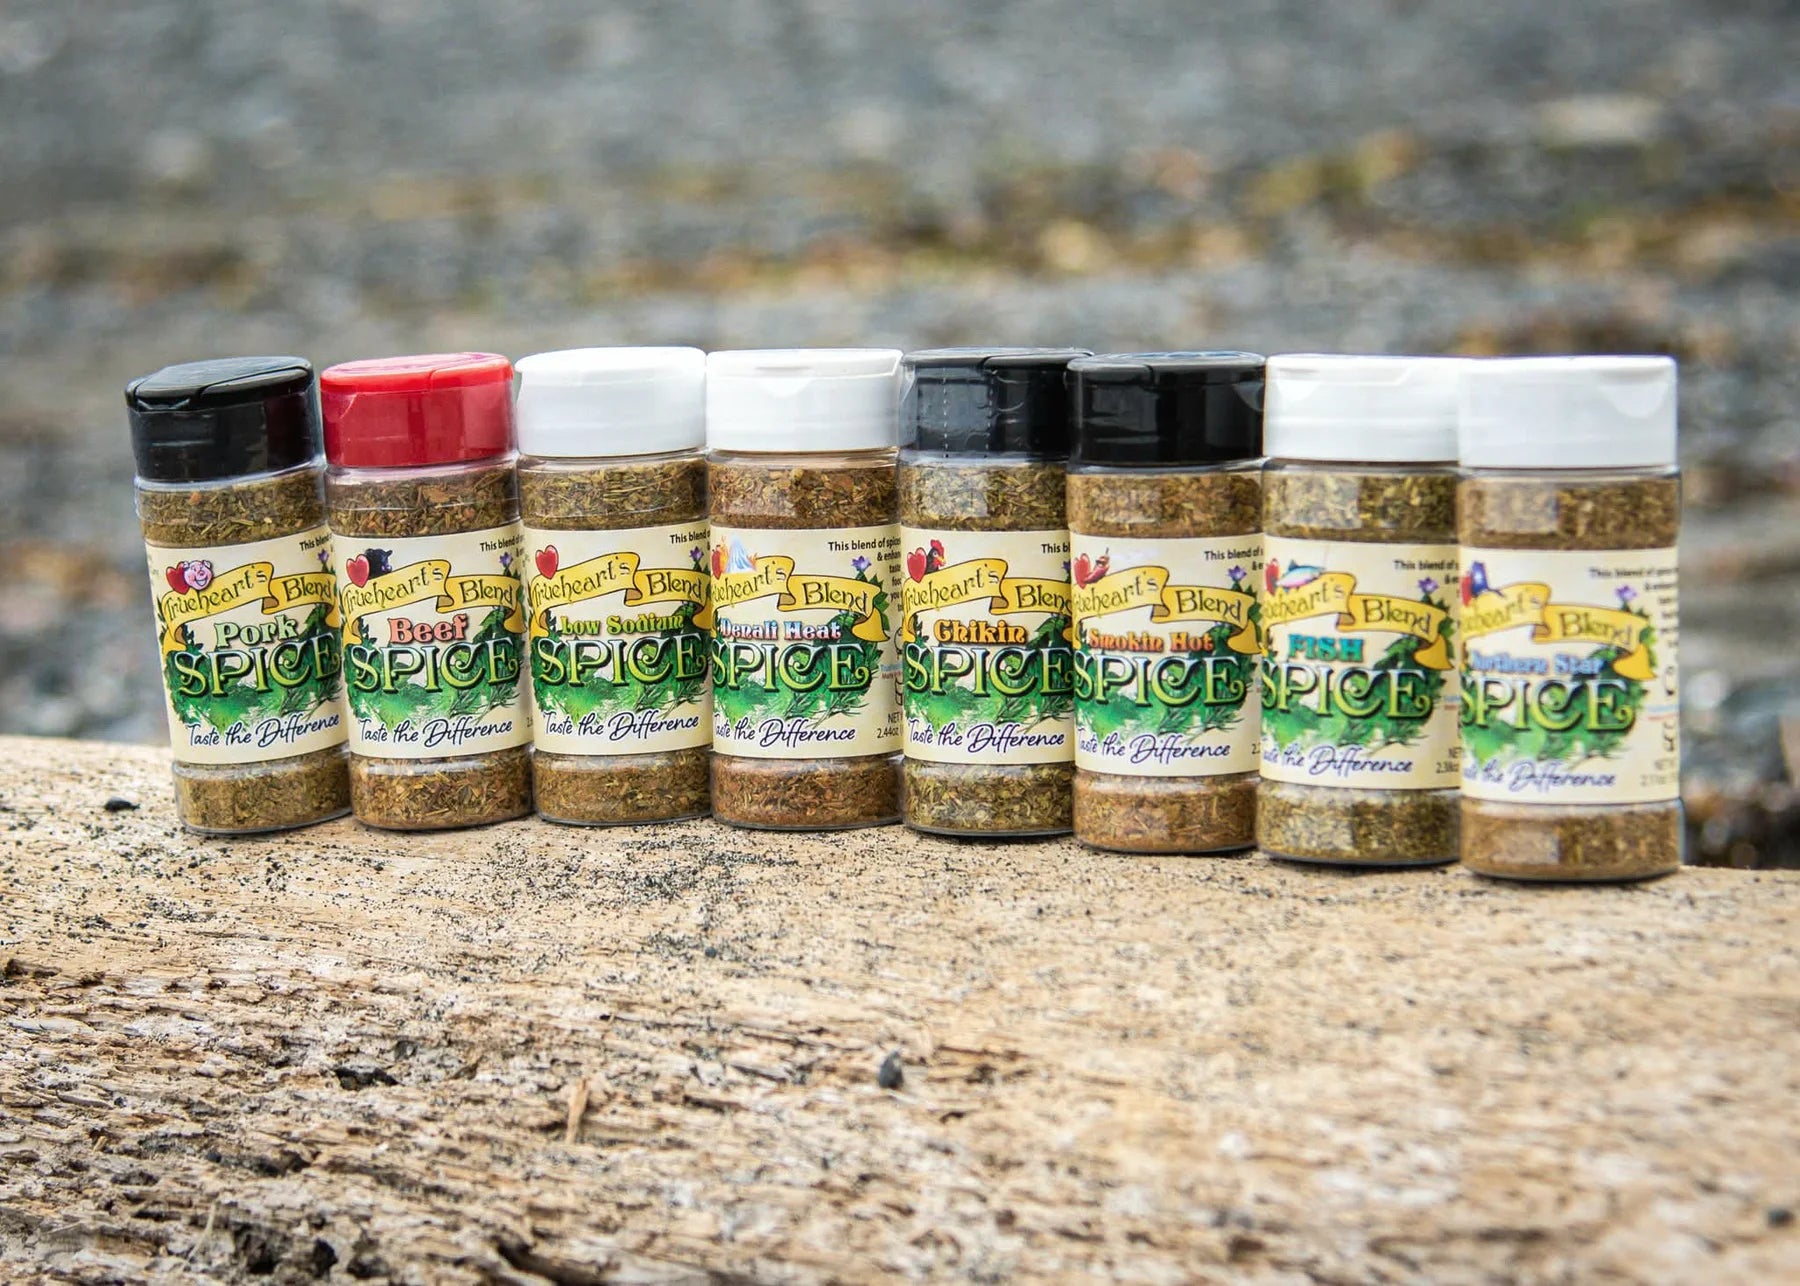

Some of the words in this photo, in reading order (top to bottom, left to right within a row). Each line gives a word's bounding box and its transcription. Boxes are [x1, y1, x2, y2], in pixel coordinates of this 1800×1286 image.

[299, 540, 315, 551] This
[480, 541, 497, 551] This
[497, 536, 515, 549] blend
[670, 533, 687, 544] This
[688, 529, 706, 541] blend
[828, 541, 849, 551] This
[852, 538, 876, 550] blend
[877, 537, 886, 548] of
[1041, 543, 1061, 553] This
[877, 552, 883, 561] &
[1204, 550, 1225, 560] This
[1227, 548, 1252, 559] blend
[282, 577, 332, 602] Blend
[459, 580, 514, 607] Blend
[646, 572, 702, 599] Blend
[801, 580, 869, 615] Blend
[1175, 588, 1242, 622] Blend
[1362, 599, 1432, 636] Blend
[214, 613, 299, 649] Pork
[387, 613, 468, 645] Beef
[560, 615, 601, 636] Low
[606, 611, 684, 636] Sodium
[720, 617, 779, 641] Denali
[783, 620, 841, 641] Heat
[933, 618, 1027, 646] Chikin
[1088, 627, 1165, 652] Smokin
[1170, 630, 1214, 651] Hot
[1559, 611, 1632, 645] Blend
[537, 632, 709, 688] SPICE
[1288, 633, 1364, 663] FISH
[174, 632, 342, 698] SPICE
[350, 637, 520, 693] SPICE
[712, 638, 872, 693] SPICE
[904, 643, 1075, 699] SPICE
[1074, 653, 1247, 707] SPICE
[186, 724, 220, 746] Taste
[226, 721, 252, 747] the
[256, 713, 340, 748] Difference
[358, 718, 388, 742] Taste
[393, 717, 419, 743] the
[423, 715, 512, 748] Difference
[543, 710, 573, 735] Taste
[578, 711, 604, 736] the
[608, 710, 699, 741] Difference
[734, 716, 756, 740] the
[758, 717, 856, 748] Difference
[908, 718, 934, 745] Taste
[937, 722, 963, 747] the
[967, 723, 1065, 753] Difference
[1102, 732, 1126, 757] the
[1129, 734, 1231, 765] Difference
[1309, 744, 1414, 777] Difference
